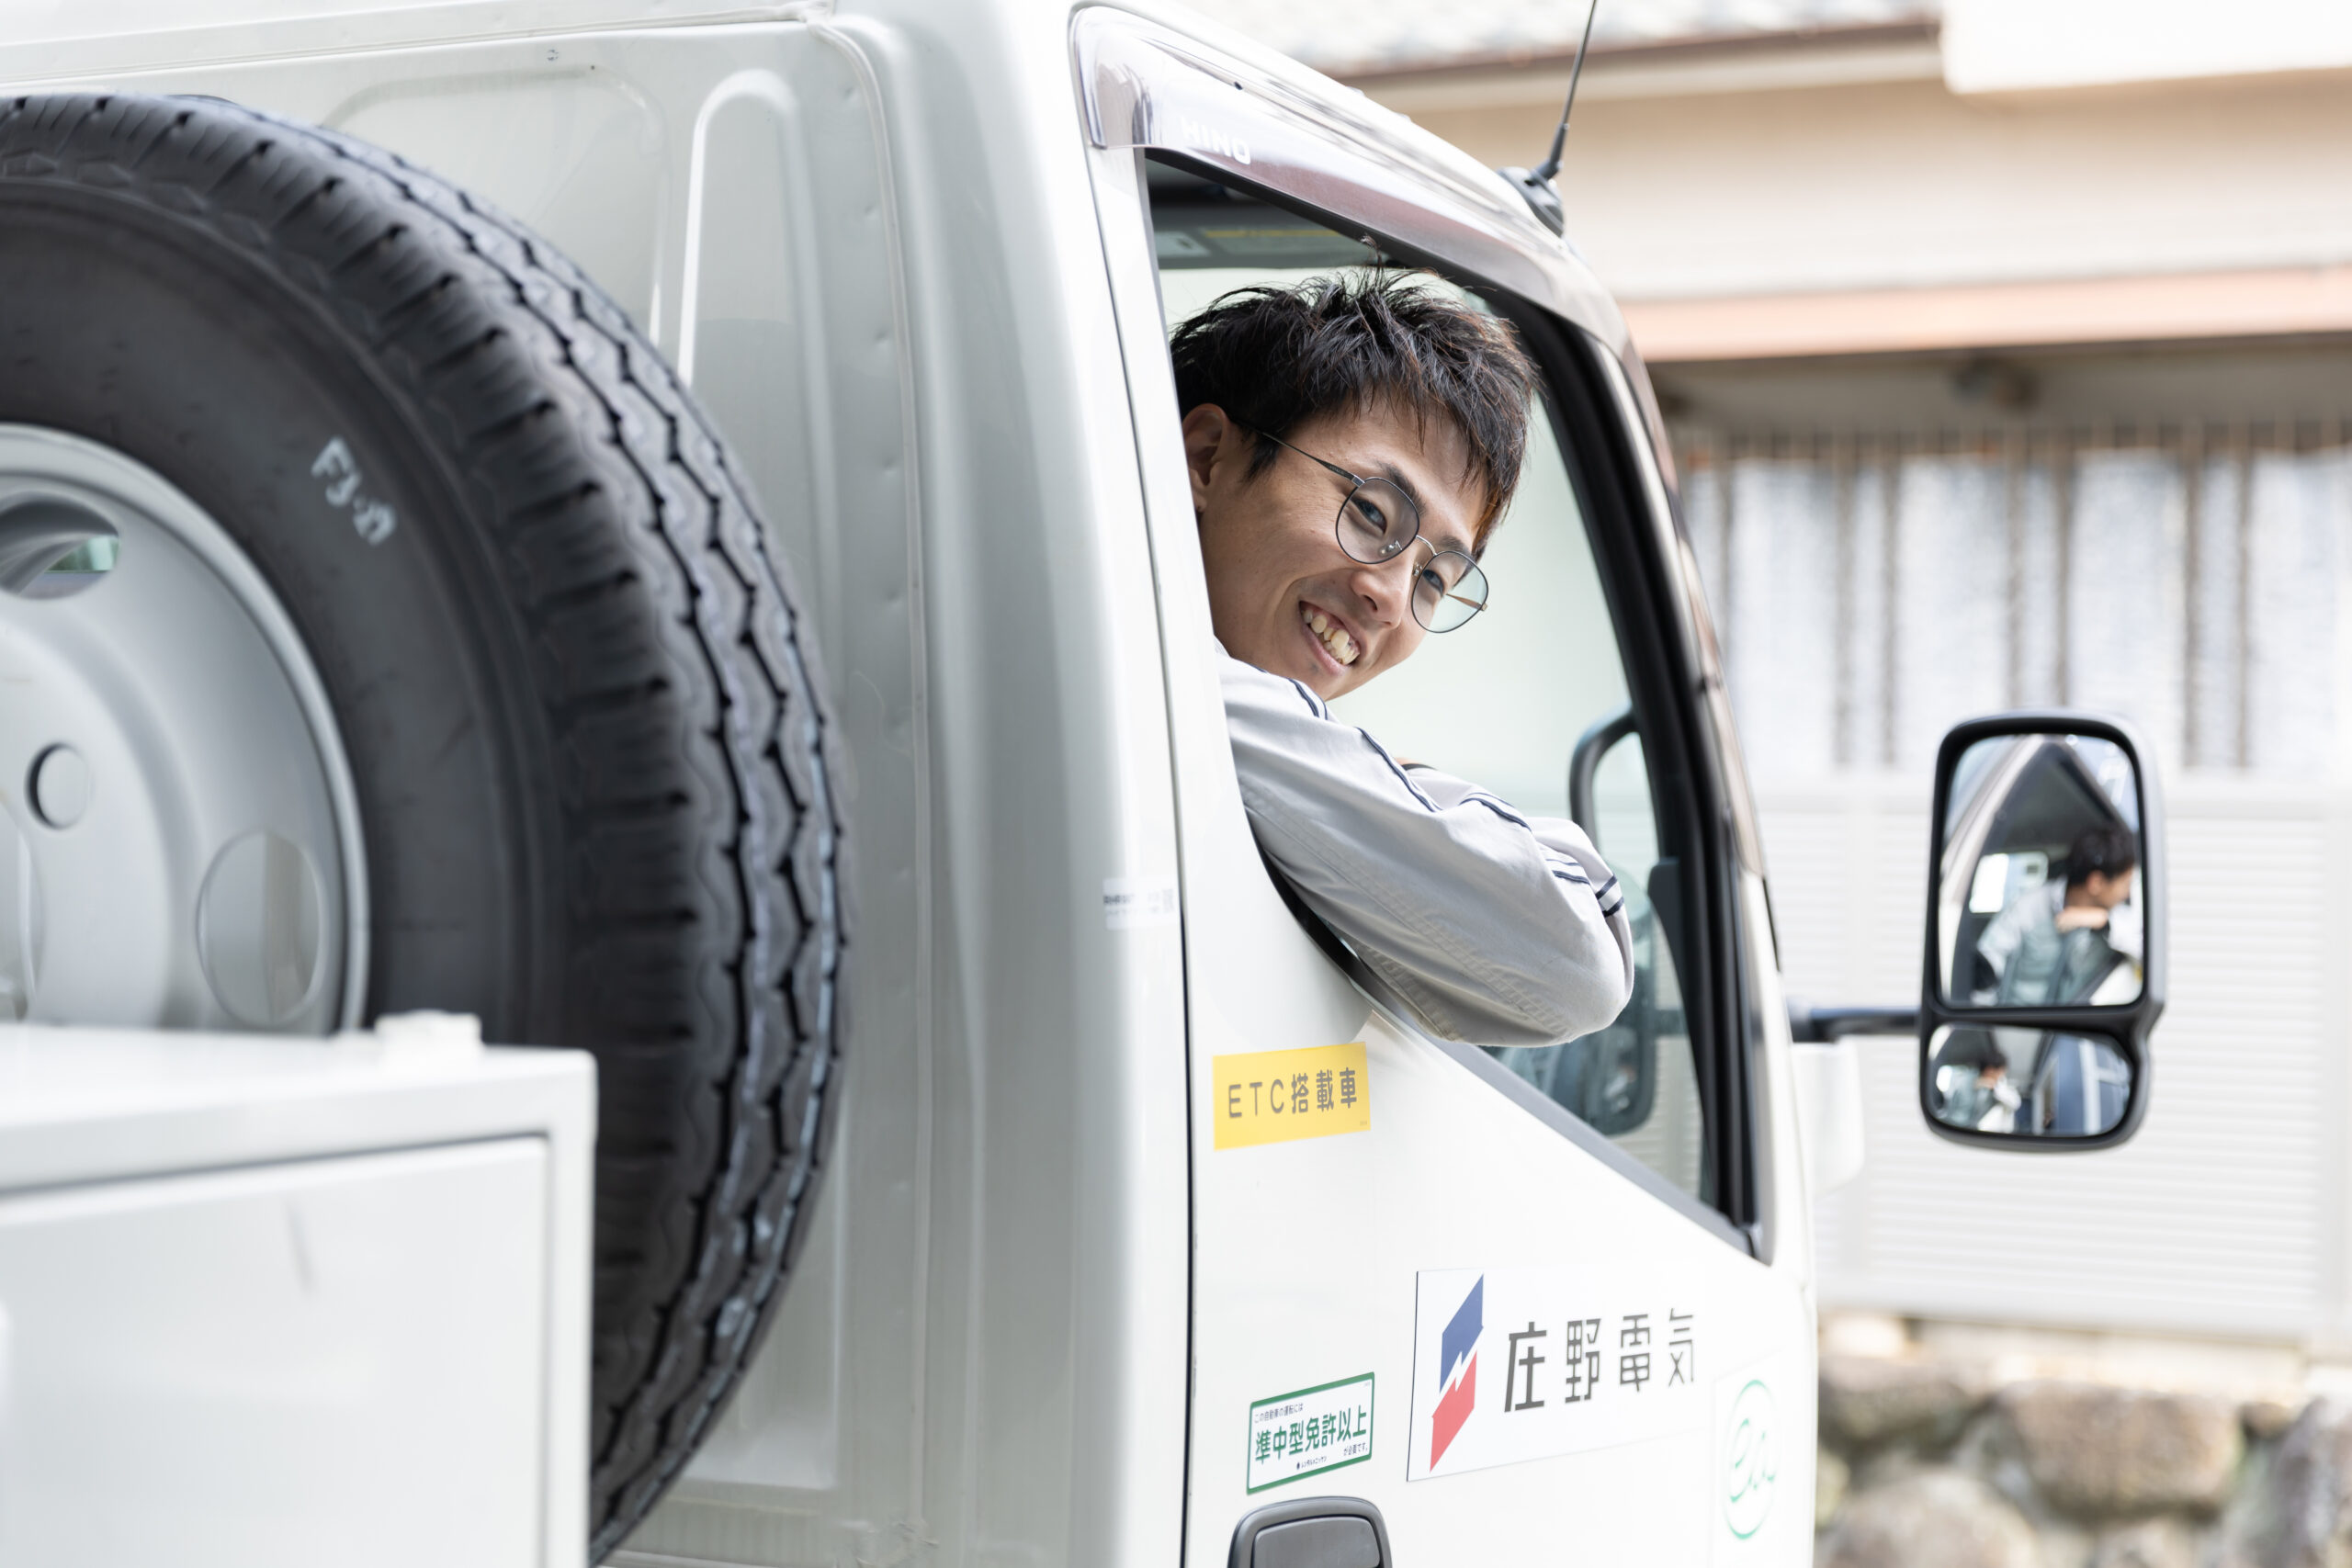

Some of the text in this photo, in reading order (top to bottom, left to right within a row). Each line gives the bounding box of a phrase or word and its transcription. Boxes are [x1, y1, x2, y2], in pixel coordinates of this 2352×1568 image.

[1180, 116, 1251, 165] HINO
[1228, 1066, 1358, 1119] ETC搭載車
[1504, 1307, 1695, 1413] 庄野電気
[1254, 1404, 1367, 1465] 準中型免許以上
